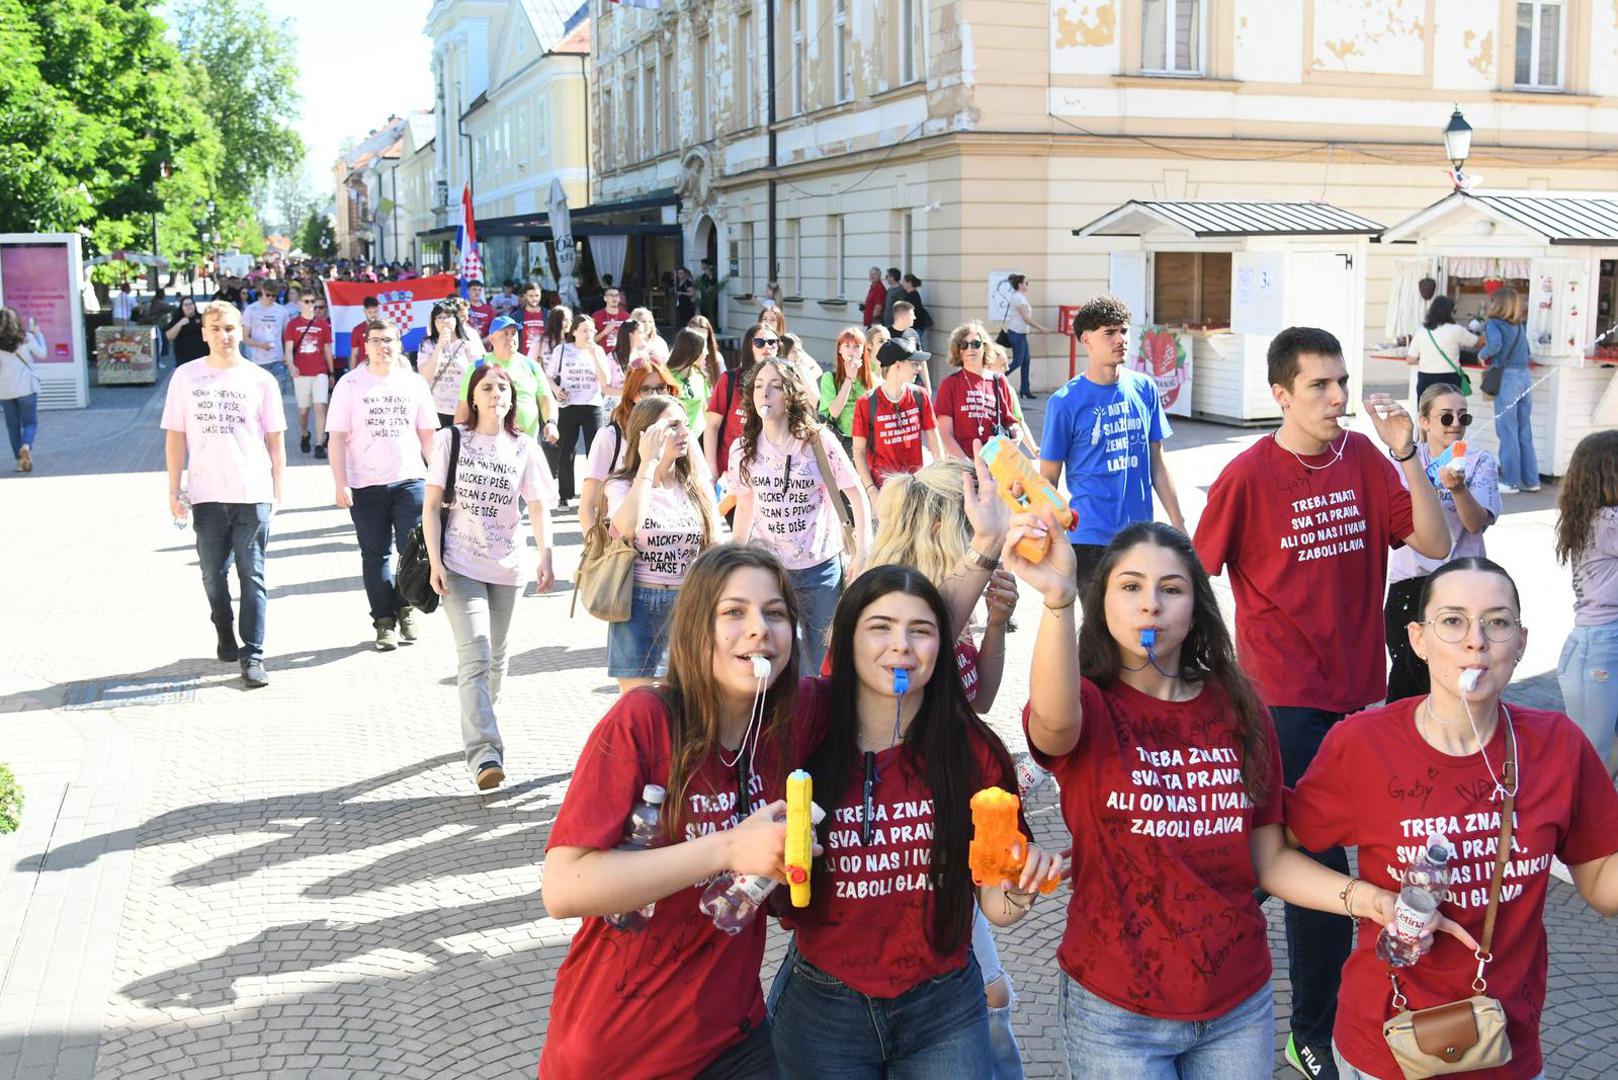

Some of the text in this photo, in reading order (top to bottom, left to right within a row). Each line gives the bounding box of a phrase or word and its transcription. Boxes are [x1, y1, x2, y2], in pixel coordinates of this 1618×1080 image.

[490, 476, 510, 492] PIŠE,
[481, 491, 487, 501] S
[1292, 489, 1356, 513] TREBA ZNATI
[785, 507, 790, 518] S
[1291, 504, 1360, 530] SVA TA PRAVA
[768, 518, 807, 534] AKŠE DIŠE
[1280, 535, 1299, 549] ALI
[1300, 532, 1316, 545] OD
[1317, 526, 1338, 541] NAS
[1339, 524, 1343, 536] I
[639, 551, 677, 563] TARZAN
[1297, 543, 1337, 562] ZABOLI
[1131, 768, 1244, 790] SVA TA PRAVA
[1106, 791, 1135, 811] ALI
[1139, 793, 1164, 812] OD
[1165, 795, 1198, 813] NAS
[1200, 794, 1207, 812] I
[829, 830, 862, 849] SVA
[890, 822, 935, 844] PRAV
[1130, 816, 1244, 838] ZABOLI GLAVA
[1400, 811, 1518, 838] TREBA ZNAI
[840, 855, 862, 873] OD
[865, 852, 900, 872] NAS
[904, 850, 910, 867] I
[1475, 863, 1481, 881] I
[835, 878, 893, 899] ZABOLI
